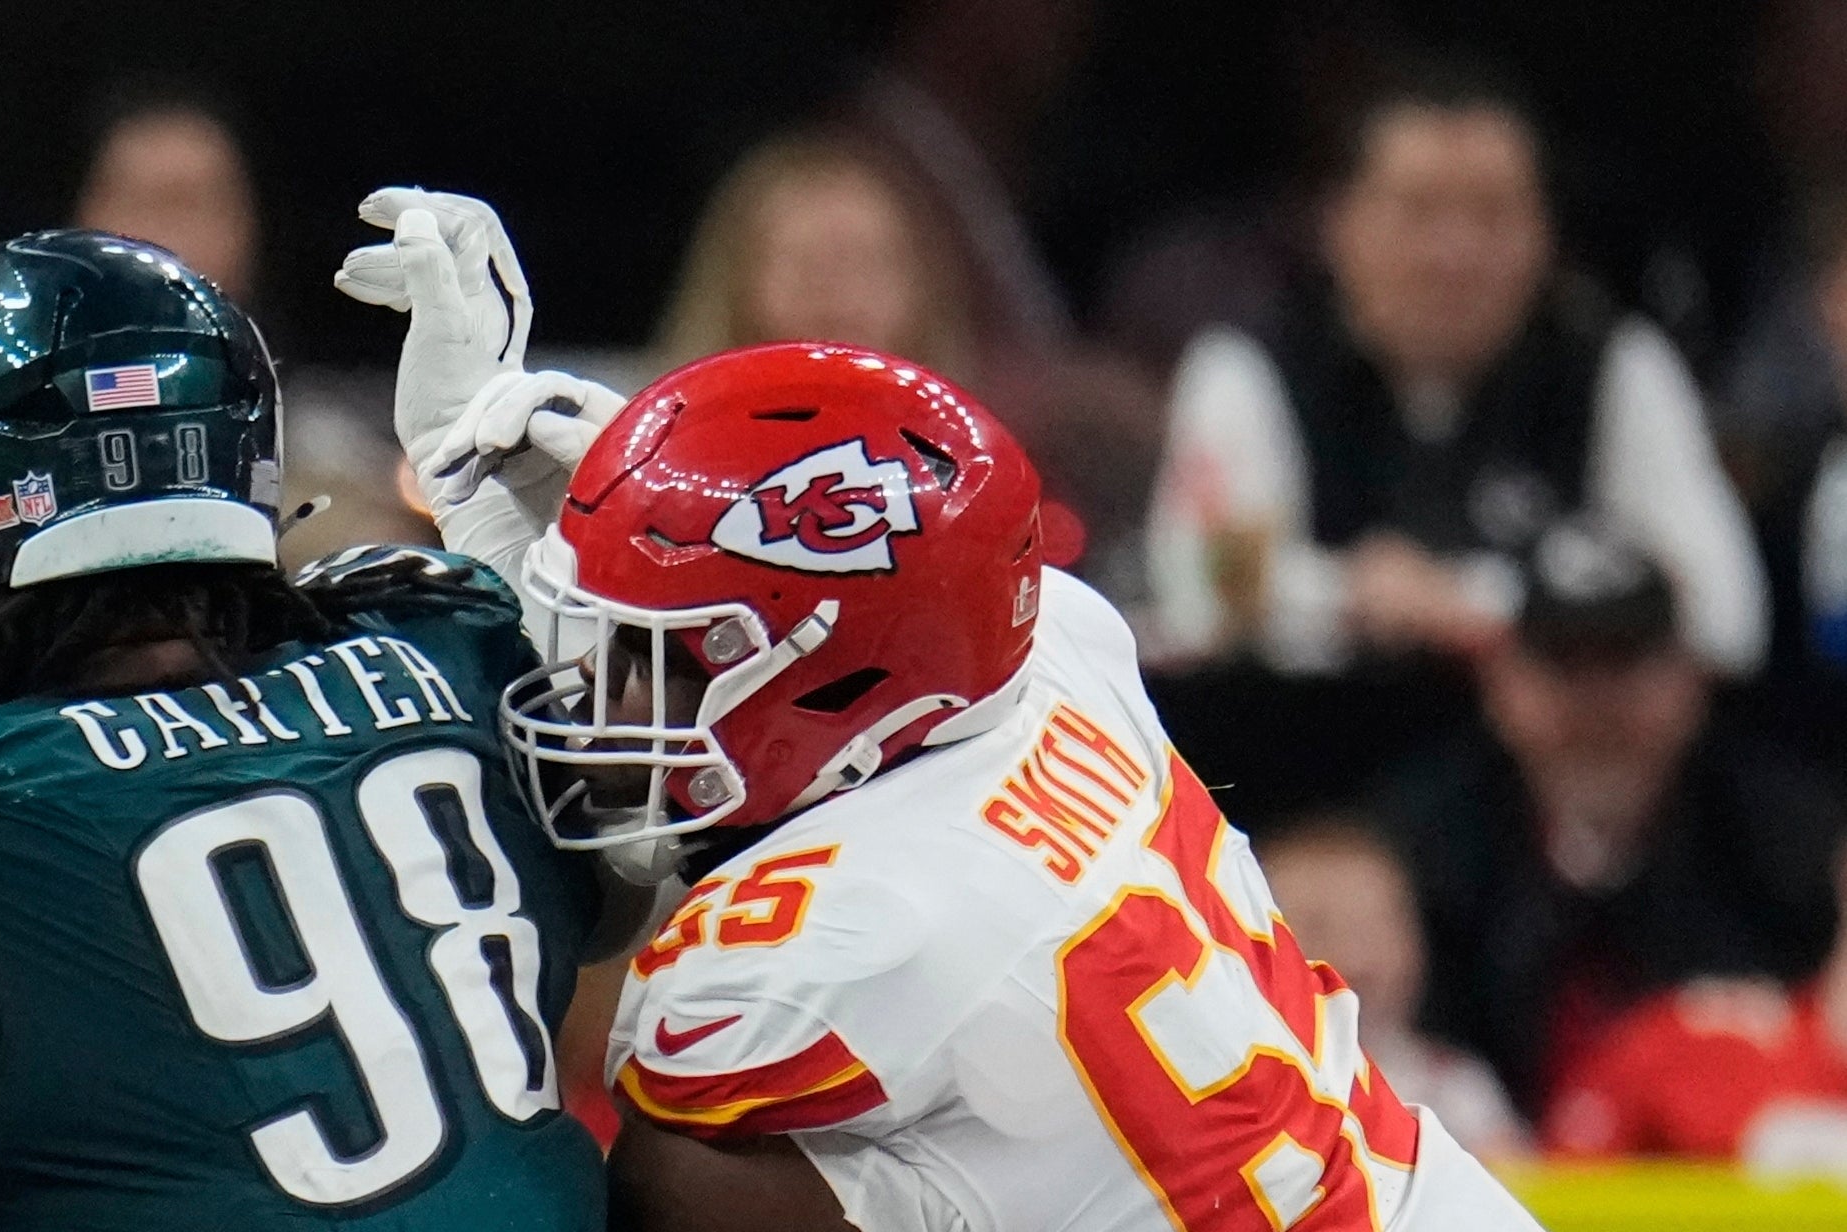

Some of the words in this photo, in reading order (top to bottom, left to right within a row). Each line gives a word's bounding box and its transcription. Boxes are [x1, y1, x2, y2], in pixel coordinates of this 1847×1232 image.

[20, 494, 53, 517] NFL
[750, 472, 891, 554] KC
[59, 636, 473, 770] CARTER
[981, 702, 1149, 886] SMITH
[136, 747, 560, 1204] 98
[630, 843, 841, 982] 65
